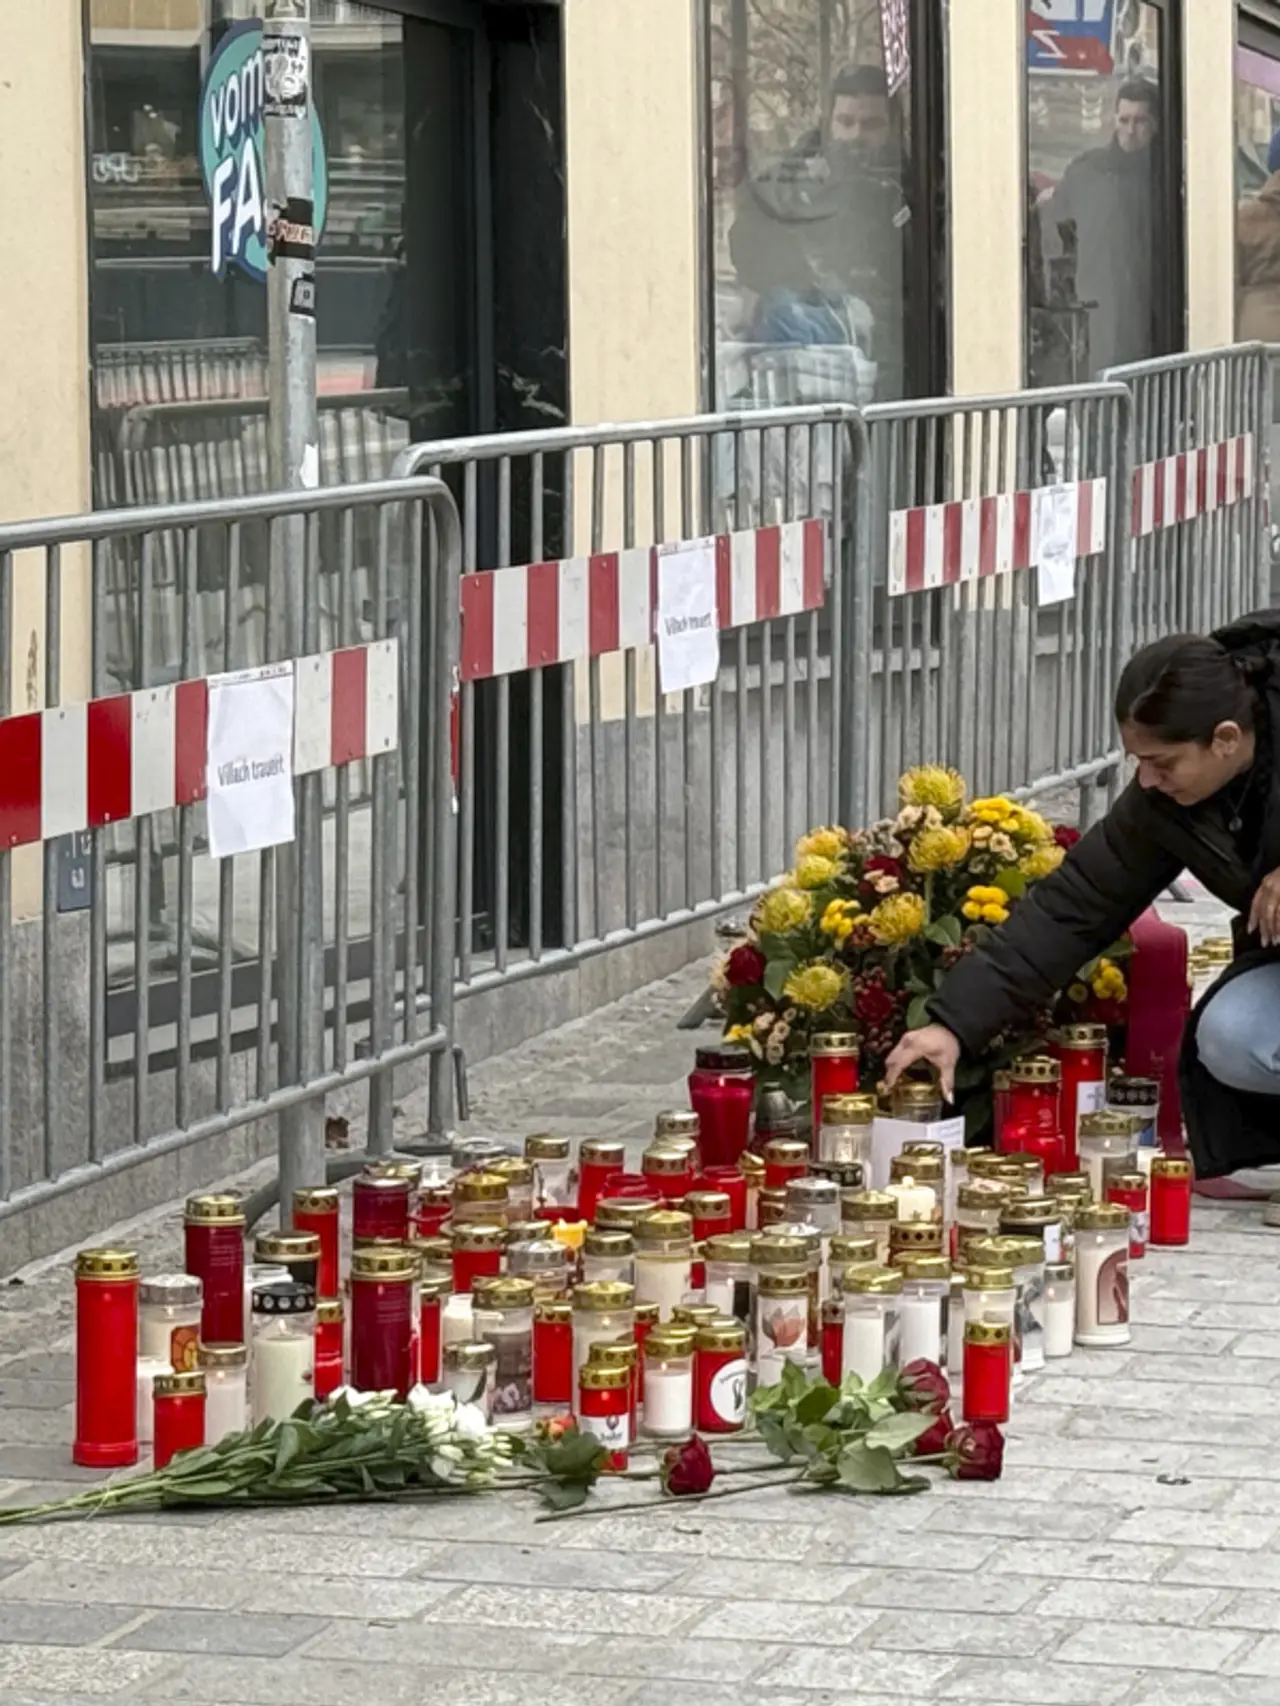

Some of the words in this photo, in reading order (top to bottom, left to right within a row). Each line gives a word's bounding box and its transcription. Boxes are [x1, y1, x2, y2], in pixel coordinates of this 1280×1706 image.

[210, 48, 262, 149] vom
[212, 137, 266, 272] FA
[217, 758, 250, 787] Villach
[251, 754, 286, 781] trauert
